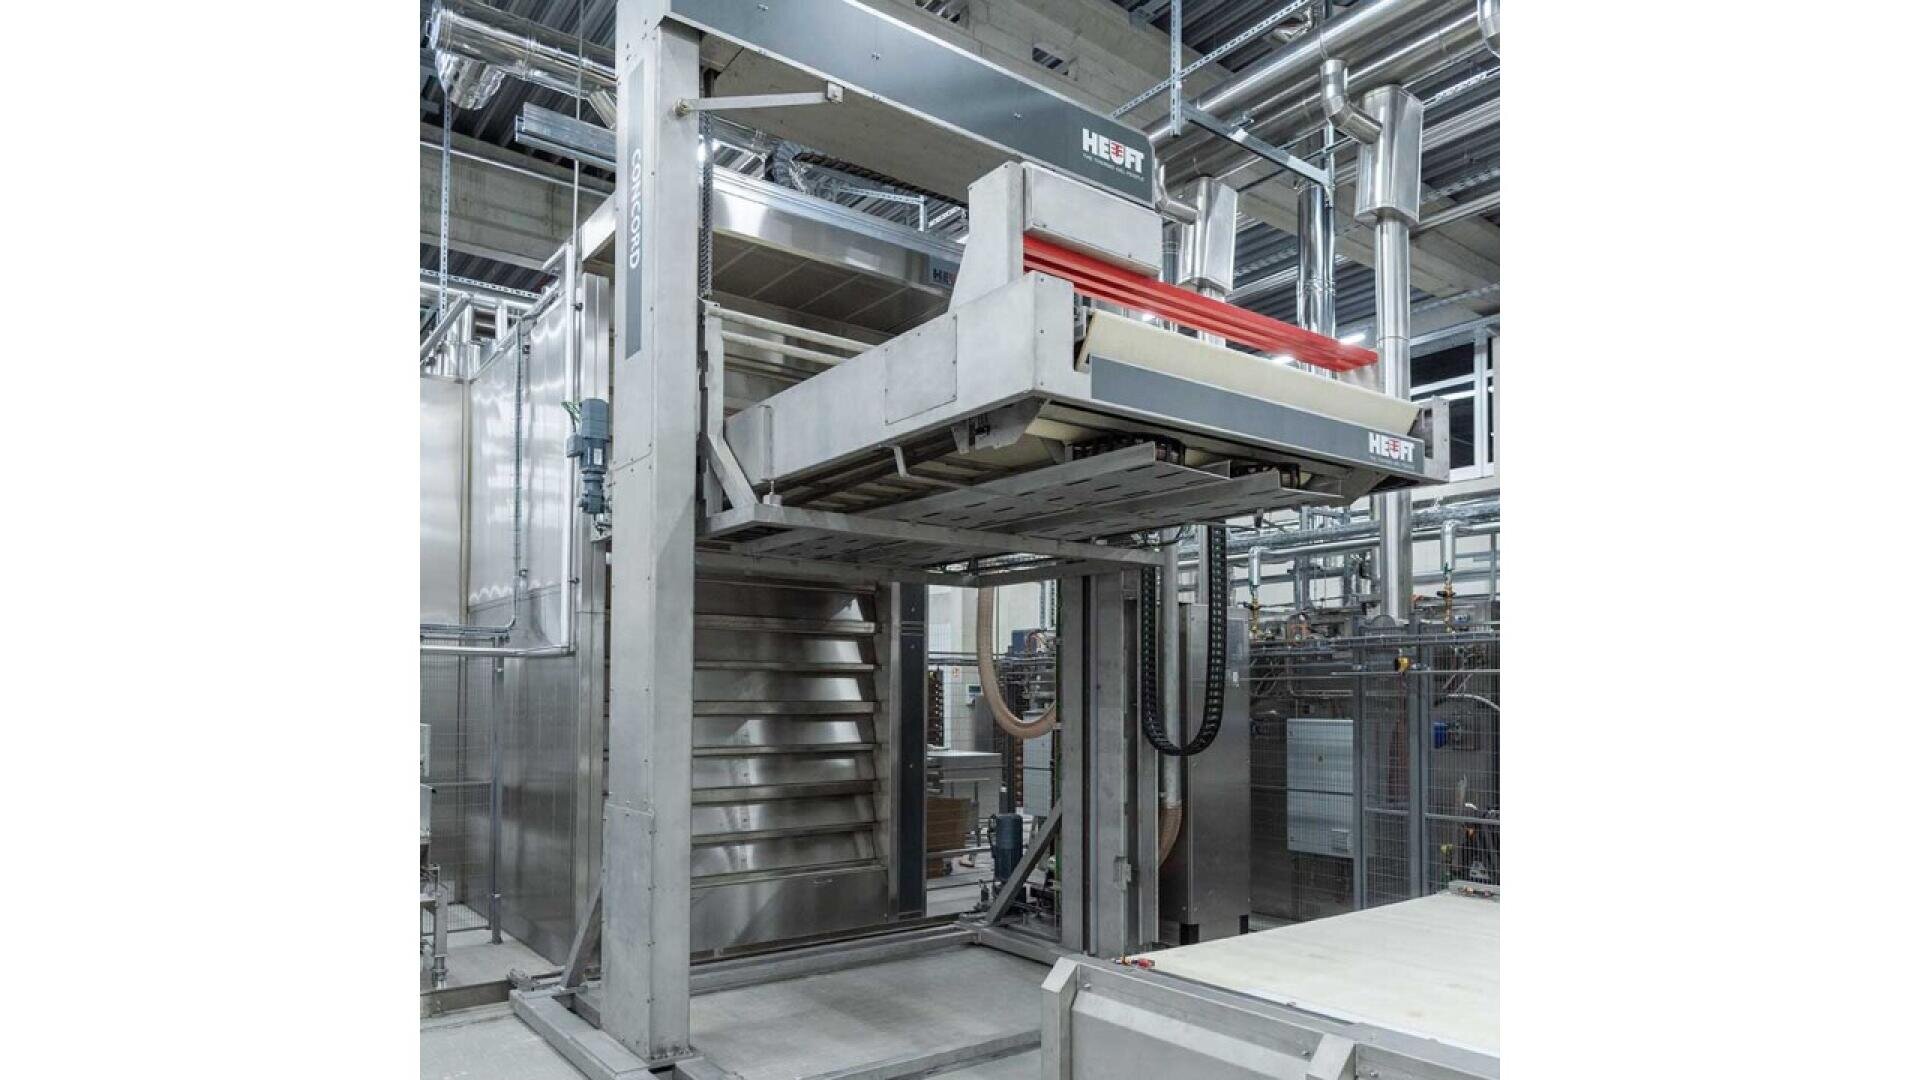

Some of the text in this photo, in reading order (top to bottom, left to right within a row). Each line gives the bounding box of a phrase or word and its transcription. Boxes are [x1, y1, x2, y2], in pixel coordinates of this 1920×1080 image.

[1082, 127, 1145, 174] HEUFT
[629, 148, 642, 270] CONCORD
[1368, 431, 1414, 463] HEUFT
